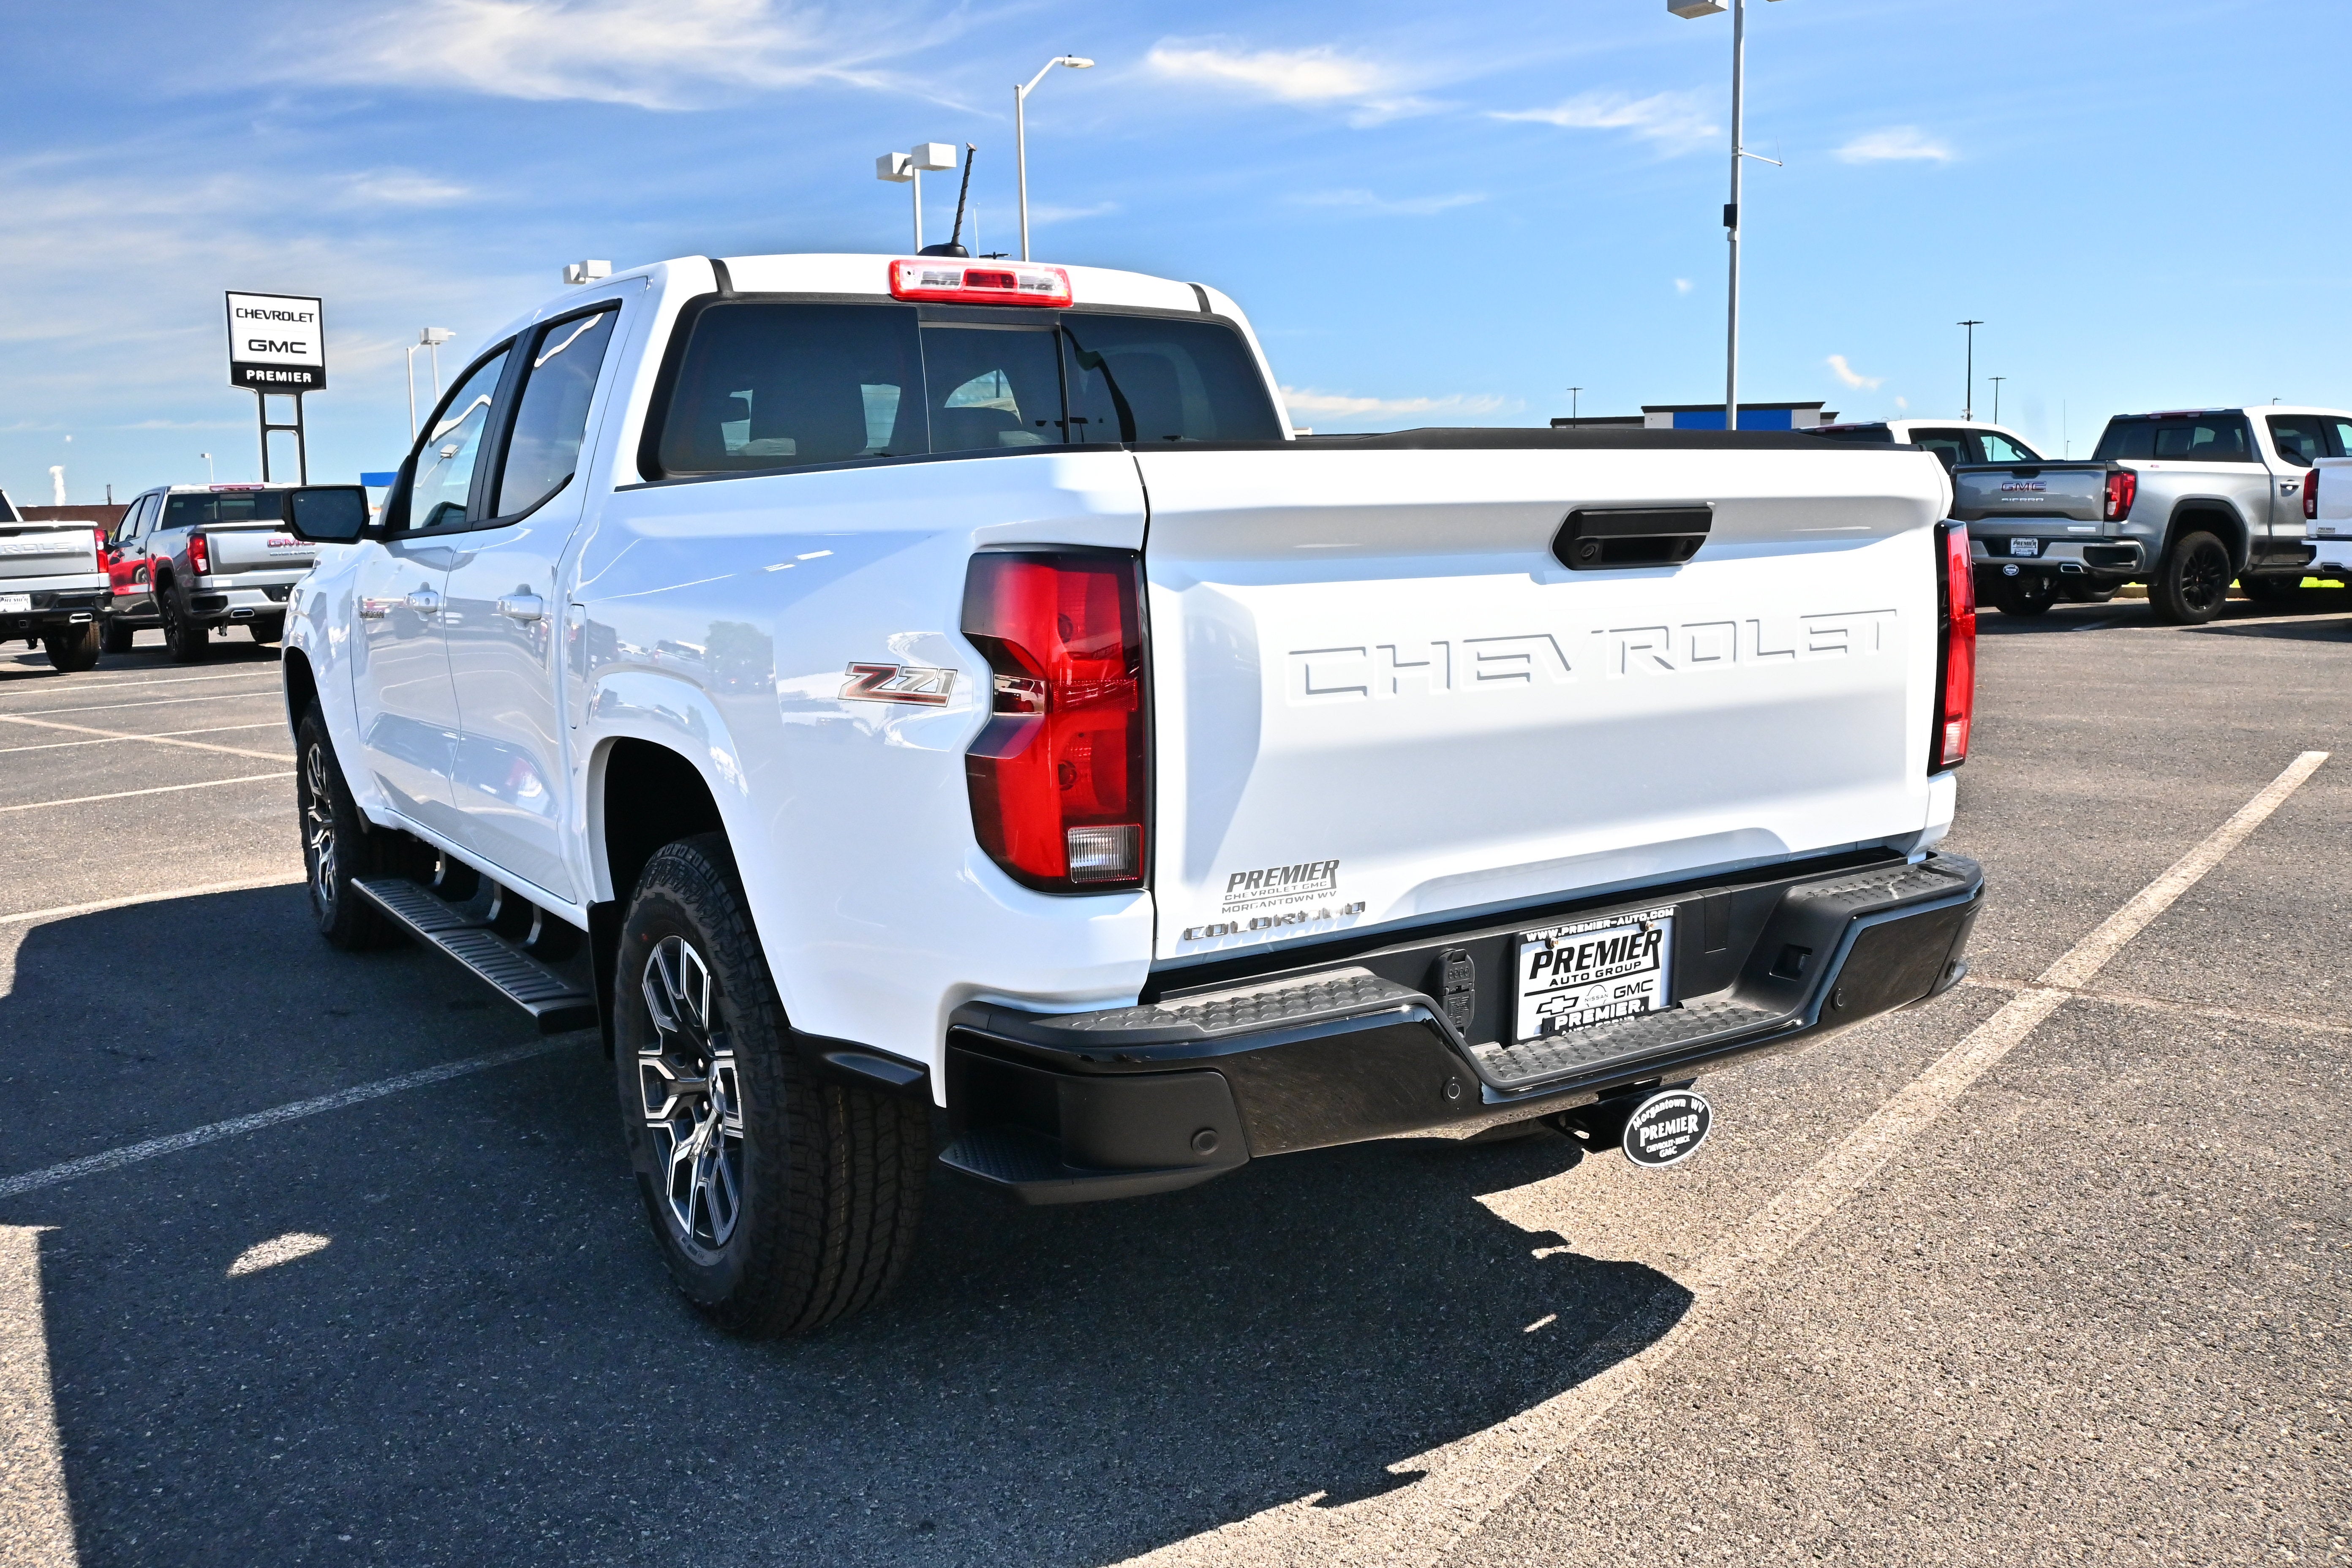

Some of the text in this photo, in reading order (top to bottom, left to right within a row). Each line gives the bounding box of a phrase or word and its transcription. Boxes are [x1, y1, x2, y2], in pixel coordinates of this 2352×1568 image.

[236, 308, 314, 322] CHEVROLET
[248, 339, 307, 354] GMC
[246, 370, 312, 382] PREMIER
[2001, 481, 2046, 492] GMC
[1286, 609, 1897, 706] CHEVROLET
[837, 662, 958, 708] Z71
[1226, 859, 1340, 893] PREMIER
[1222, 891, 1337, 914] MORGANTOWN WV
[1225, 881, 1327, 901] CHEVROLET GMC
[1526, 908, 1674, 942] WWW.PREMIER-AUTO.COM
[1529, 929, 1662, 980] PREMIER
[1549, 961, 1642, 987] AUTO GROUP
[1584, 979, 1653, 1002] NISSAN GMC
[1633, 1098, 1705, 1131] Morgantown WV
[1639, 1114, 1699, 1147] PREMIER
[1659, 1146, 1678, 1158] GMC
